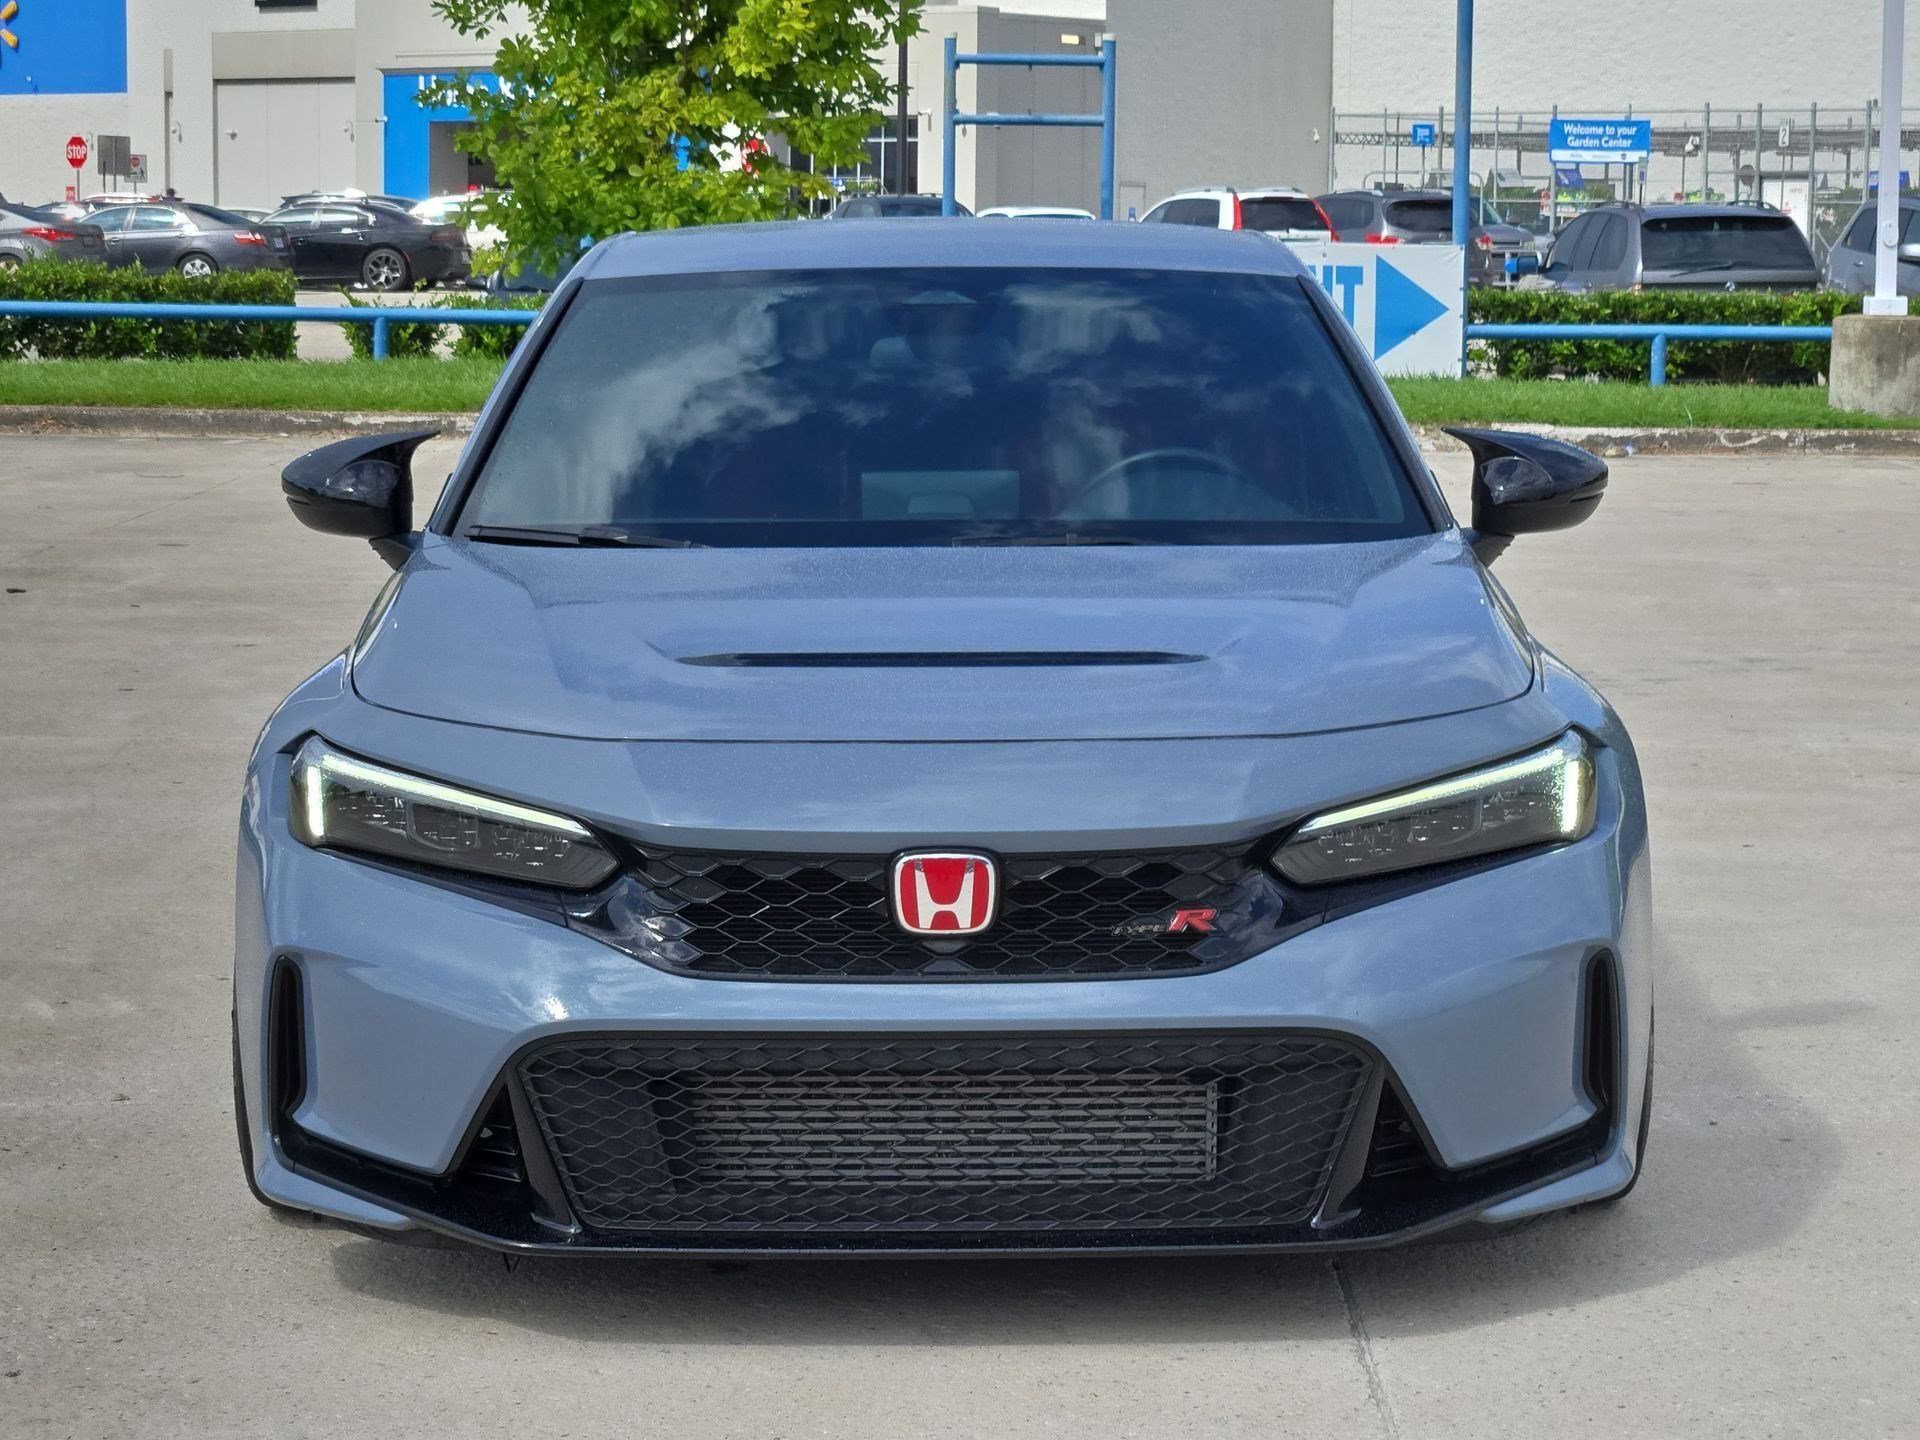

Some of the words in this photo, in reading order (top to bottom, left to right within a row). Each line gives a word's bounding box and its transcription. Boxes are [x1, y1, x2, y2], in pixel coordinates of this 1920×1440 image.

[1564, 123, 1603, 134] Welcome
[1605, 124, 1615, 134] to
[1617, 125, 1637, 137] your
[1567, 136, 1600, 147] Garden
[1601, 137, 1632, 147] Center
[67, 145, 87, 159] STOP
[1166, 909, 1217, 932] R
